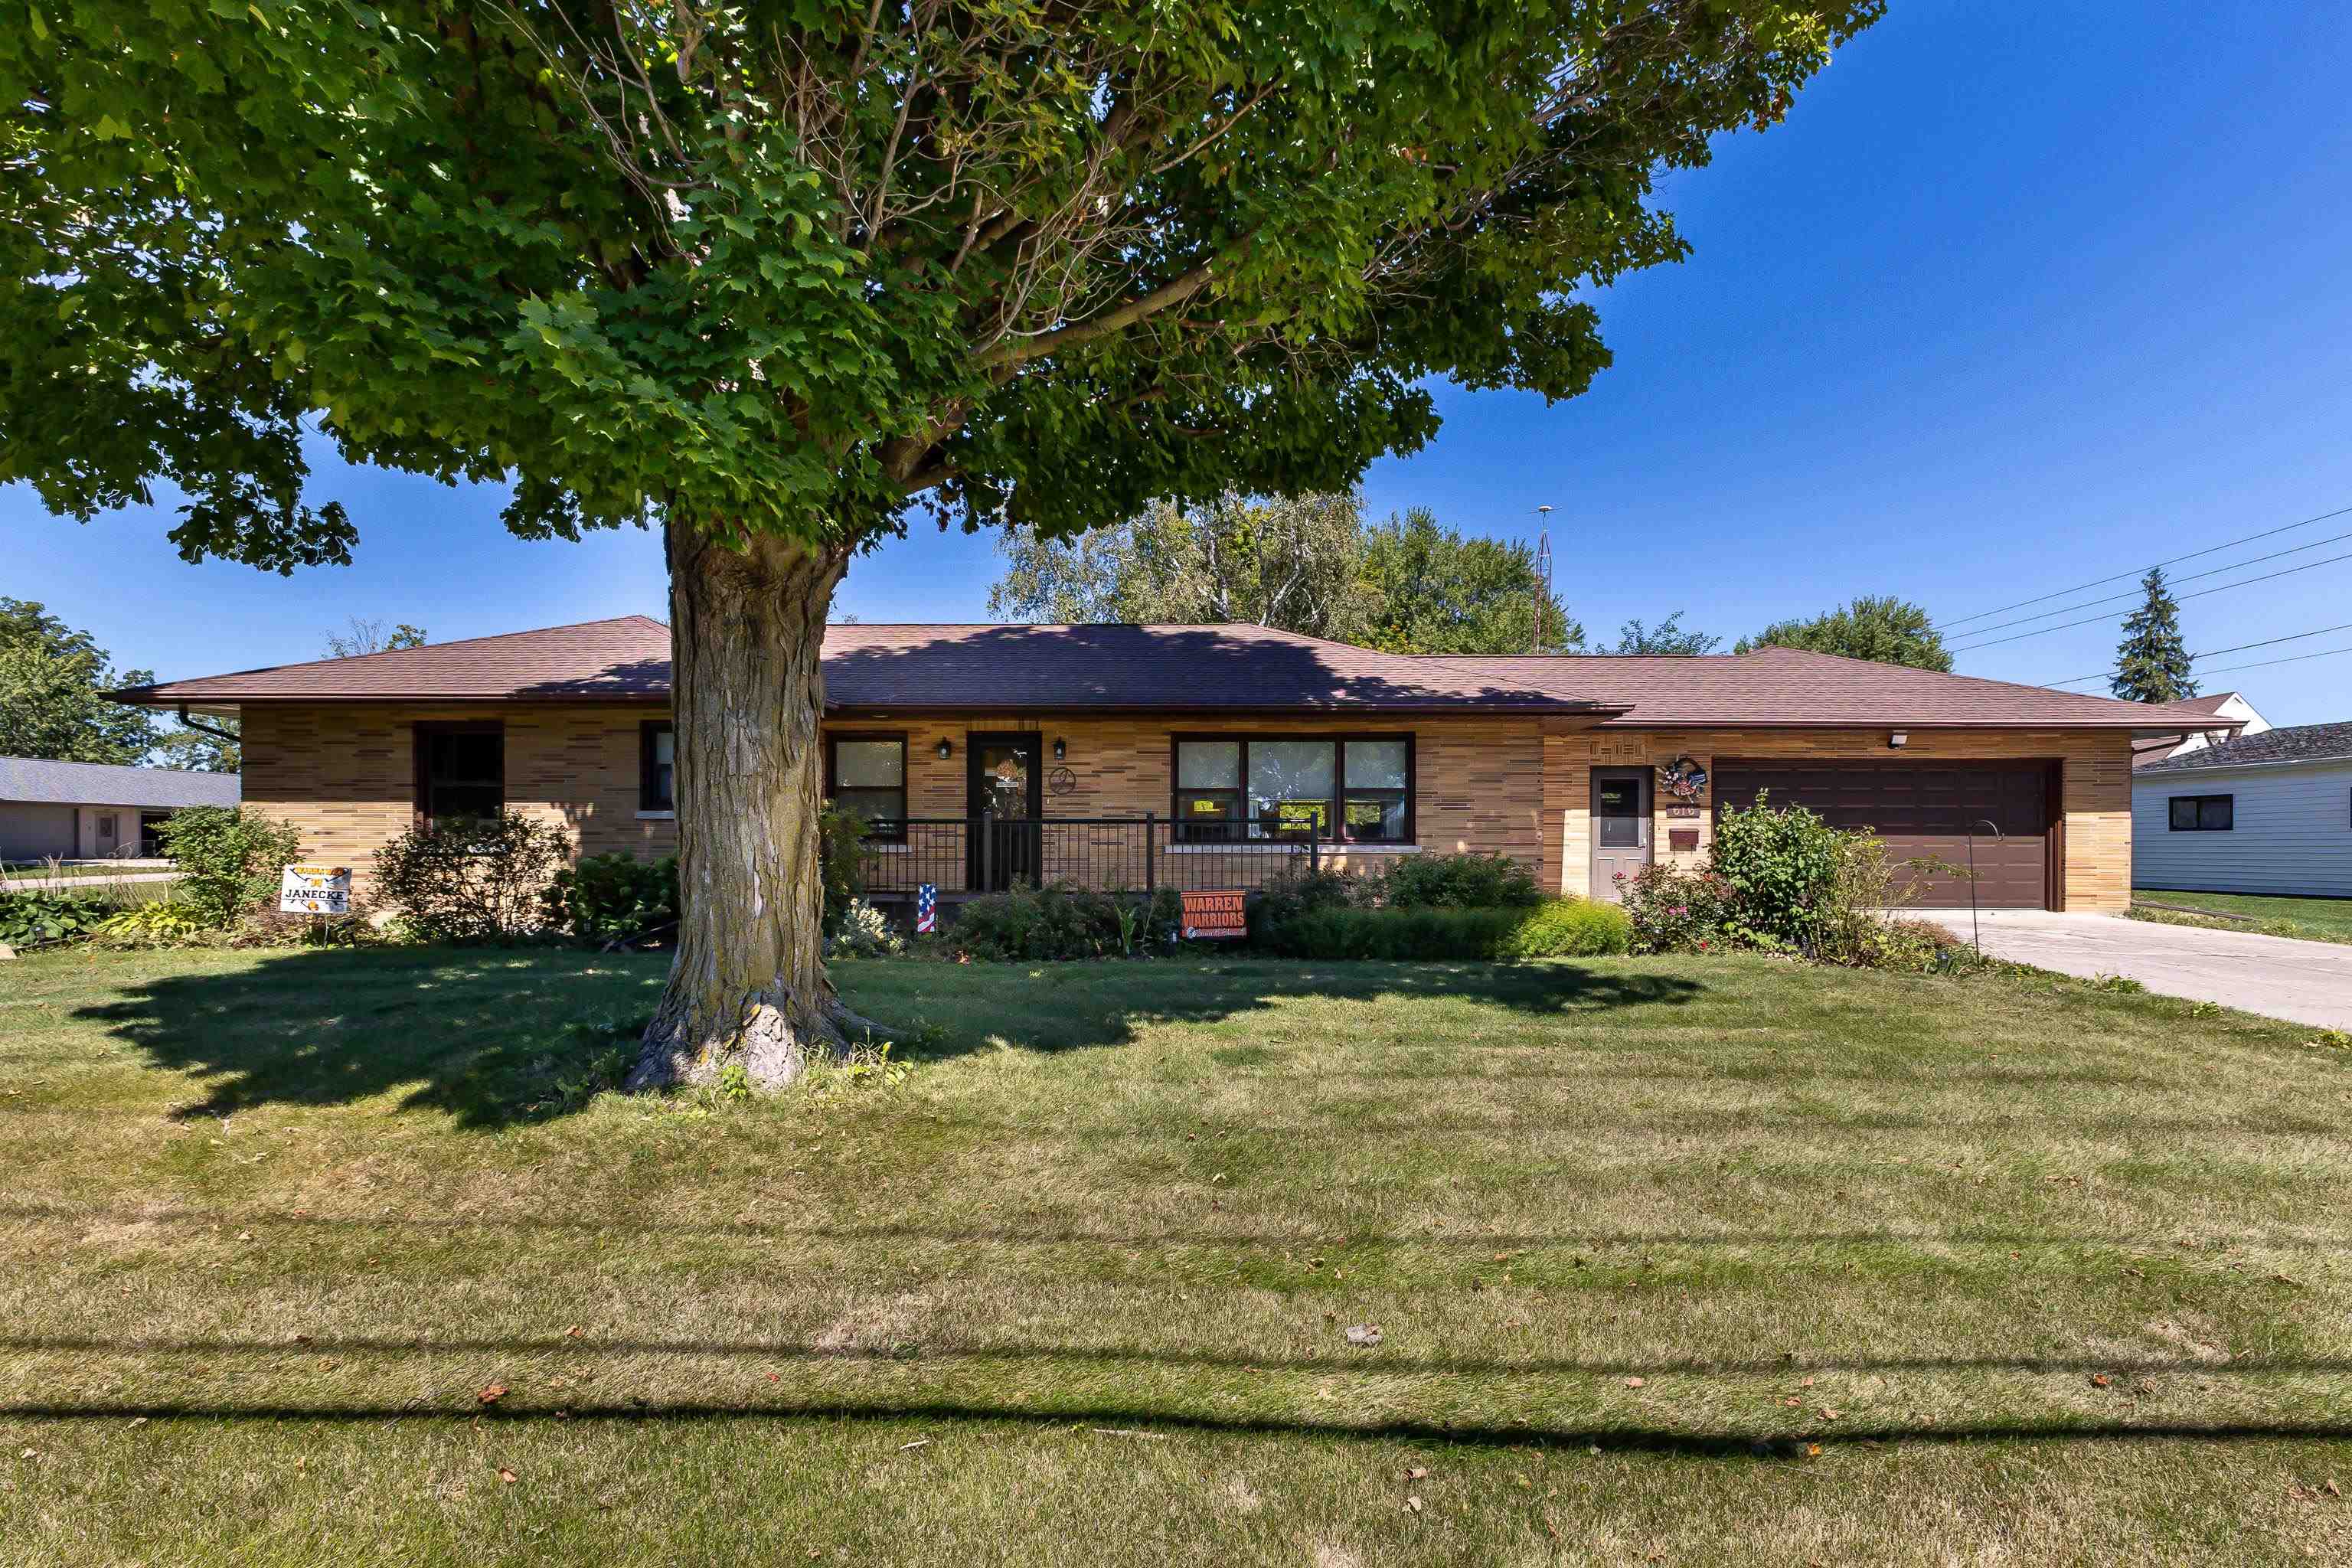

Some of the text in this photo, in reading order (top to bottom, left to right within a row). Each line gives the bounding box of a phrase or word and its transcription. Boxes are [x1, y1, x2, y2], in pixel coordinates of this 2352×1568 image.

[286, 889, 344, 900] JANECKE
[1184, 895, 1243, 911] WARREN
[1182, 912, 1245, 927] WARRIORS
